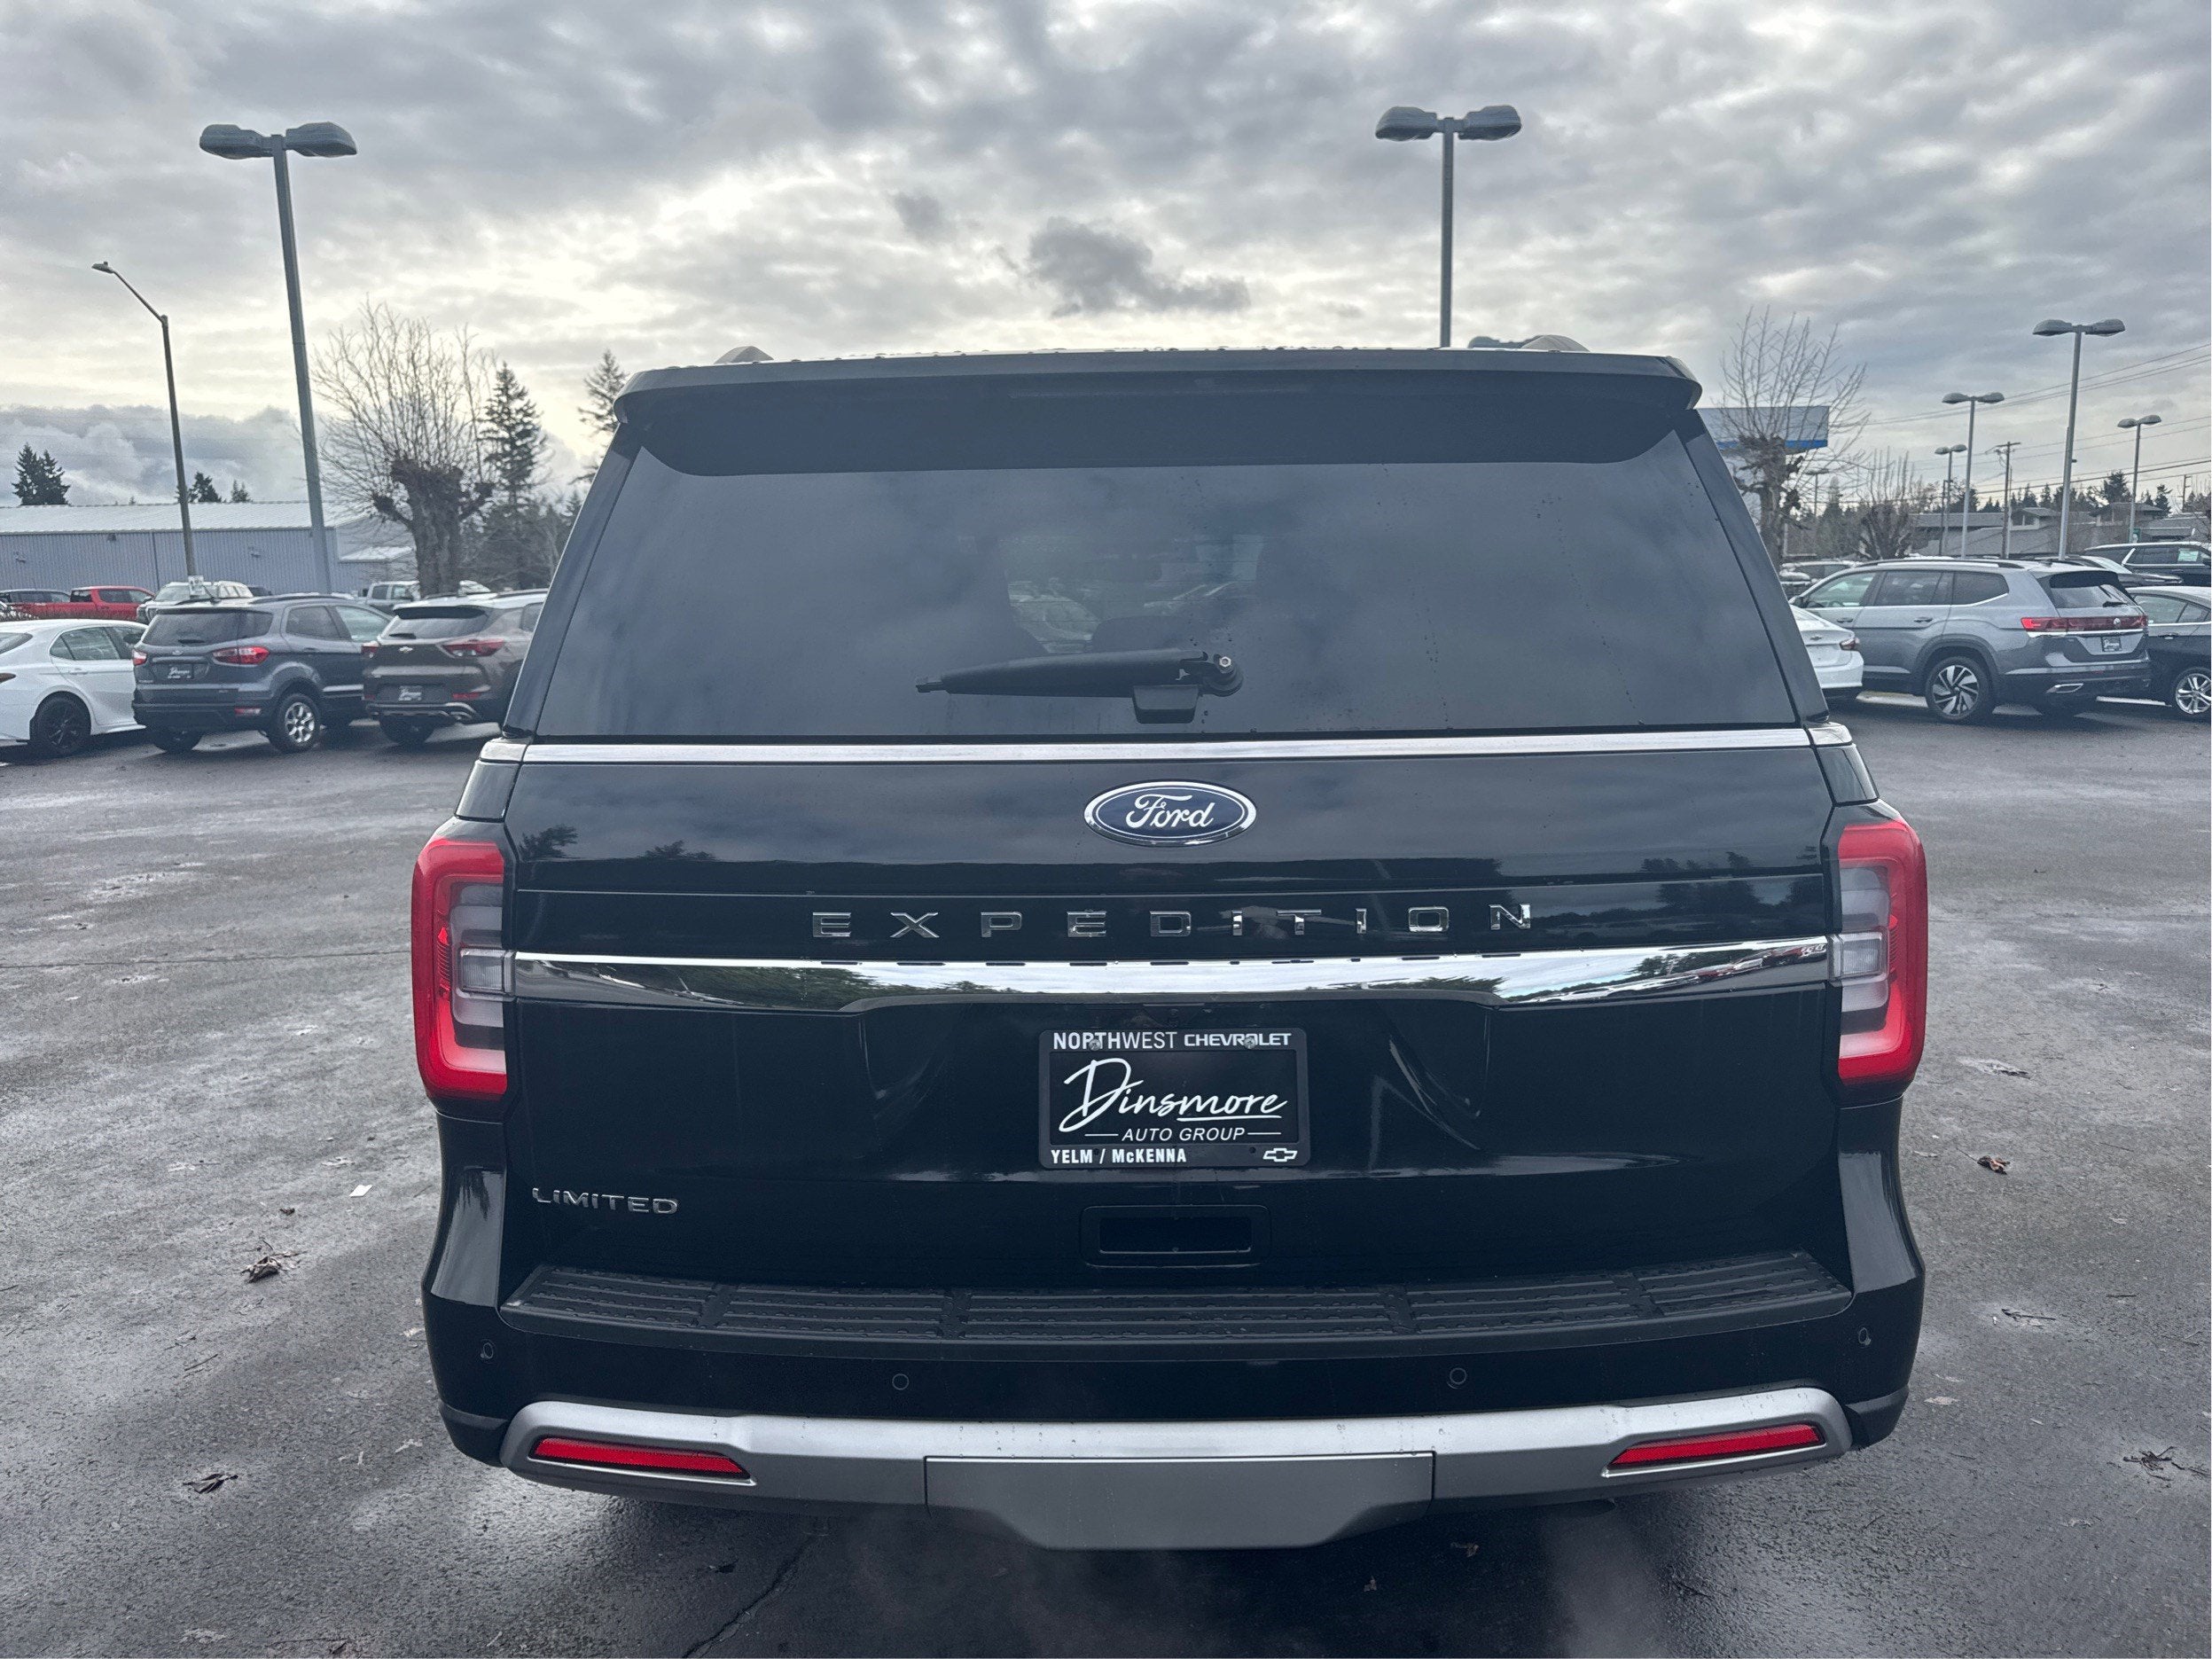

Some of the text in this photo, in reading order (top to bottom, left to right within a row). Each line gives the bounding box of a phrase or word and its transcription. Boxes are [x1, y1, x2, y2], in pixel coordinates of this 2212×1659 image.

[1125, 794, 1215, 828] Ford
[811, 903, 1533, 938] EXPEDITION
[1053, 1031, 1177, 1050] NORTHWEST
[1059, 1058, 1287, 1131] Dinsmore
[1122, 1127, 1246, 1142] AUTO GROUP
[1051, 1149, 1093, 1163] YELM
[1112, 1148, 1187, 1163] McKENNA
[532, 1187, 679, 1215] LIMITED
